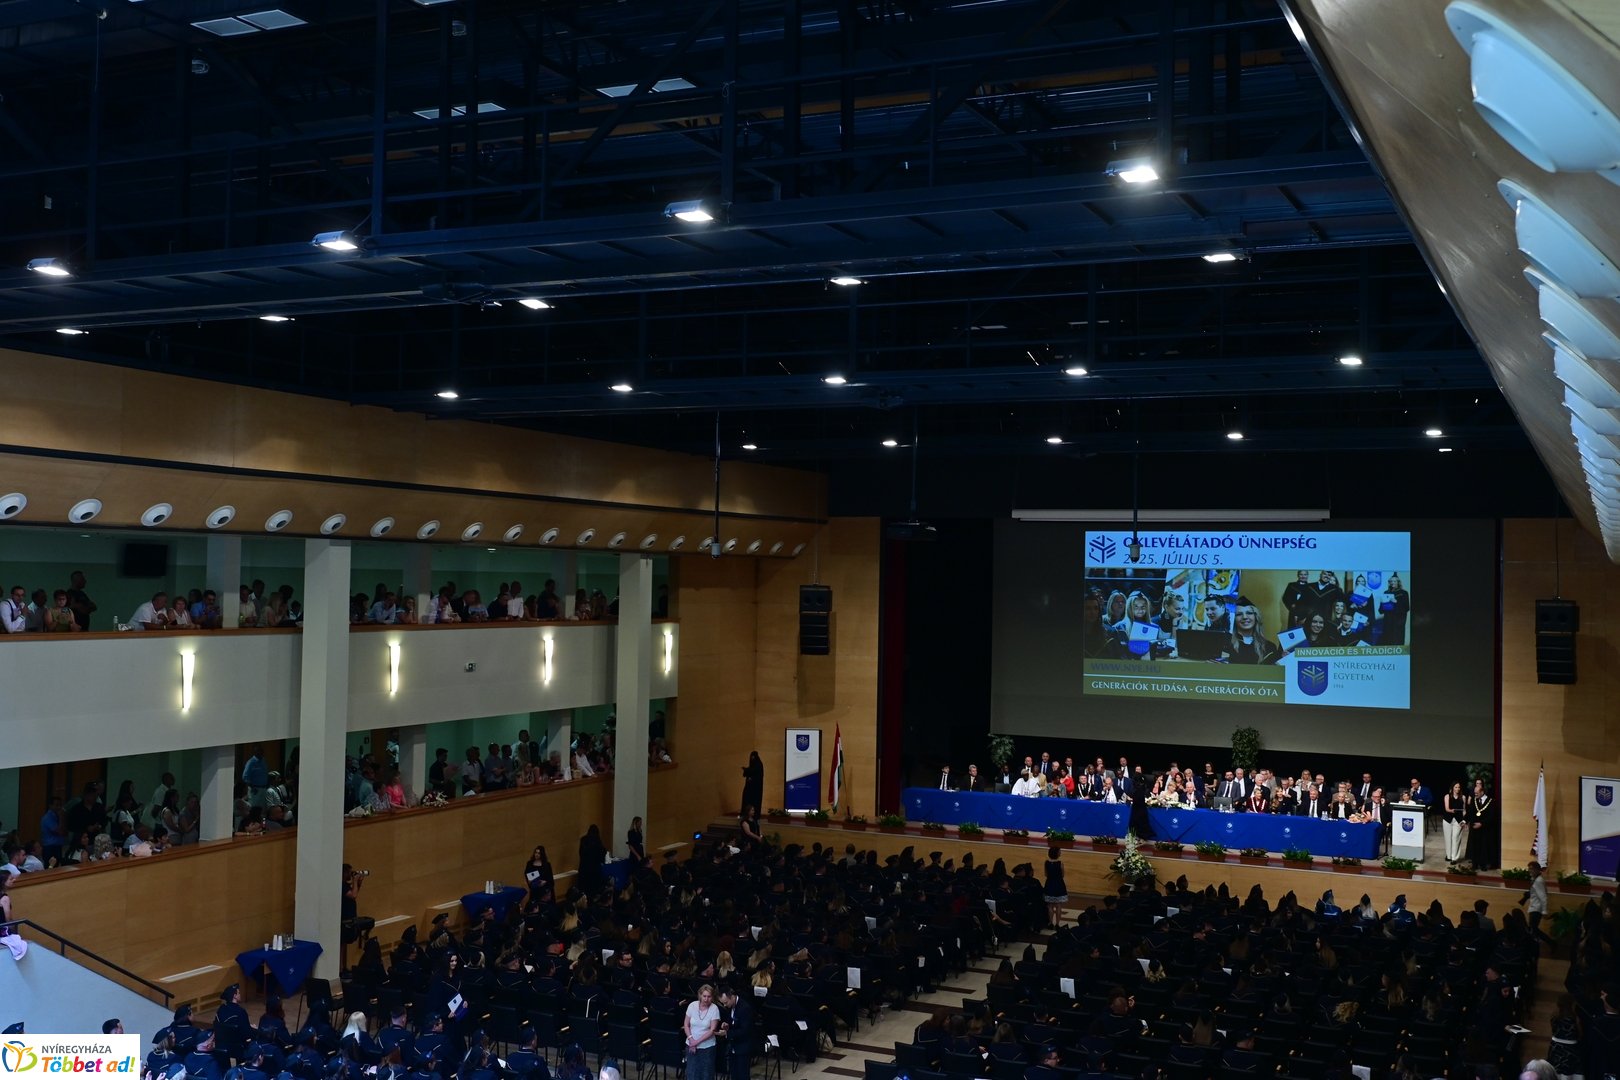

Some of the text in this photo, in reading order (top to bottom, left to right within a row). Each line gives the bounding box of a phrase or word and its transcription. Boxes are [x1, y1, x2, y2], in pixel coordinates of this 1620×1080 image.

[1238, 534, 1317, 549] ÜNNEPSÉG
[1123, 551, 1223, 566] 225. JÚLIUS 5.
[1297, 646, 1403, 656] INNOVÁCIÓ ÉS TRADÍCIÓ
[1333, 661, 1396, 671] NYÍREGYHÁZI
[1333, 673, 1374, 681] EGYETEM
[1091, 680, 1149, 691] GENERÁCIÓK
[1151, 682, 1188, 693] TUDÁSA
[1195, 684, 1256, 696] GENERÁCIÓK
[1258, 686, 1279, 697] ÓTA
